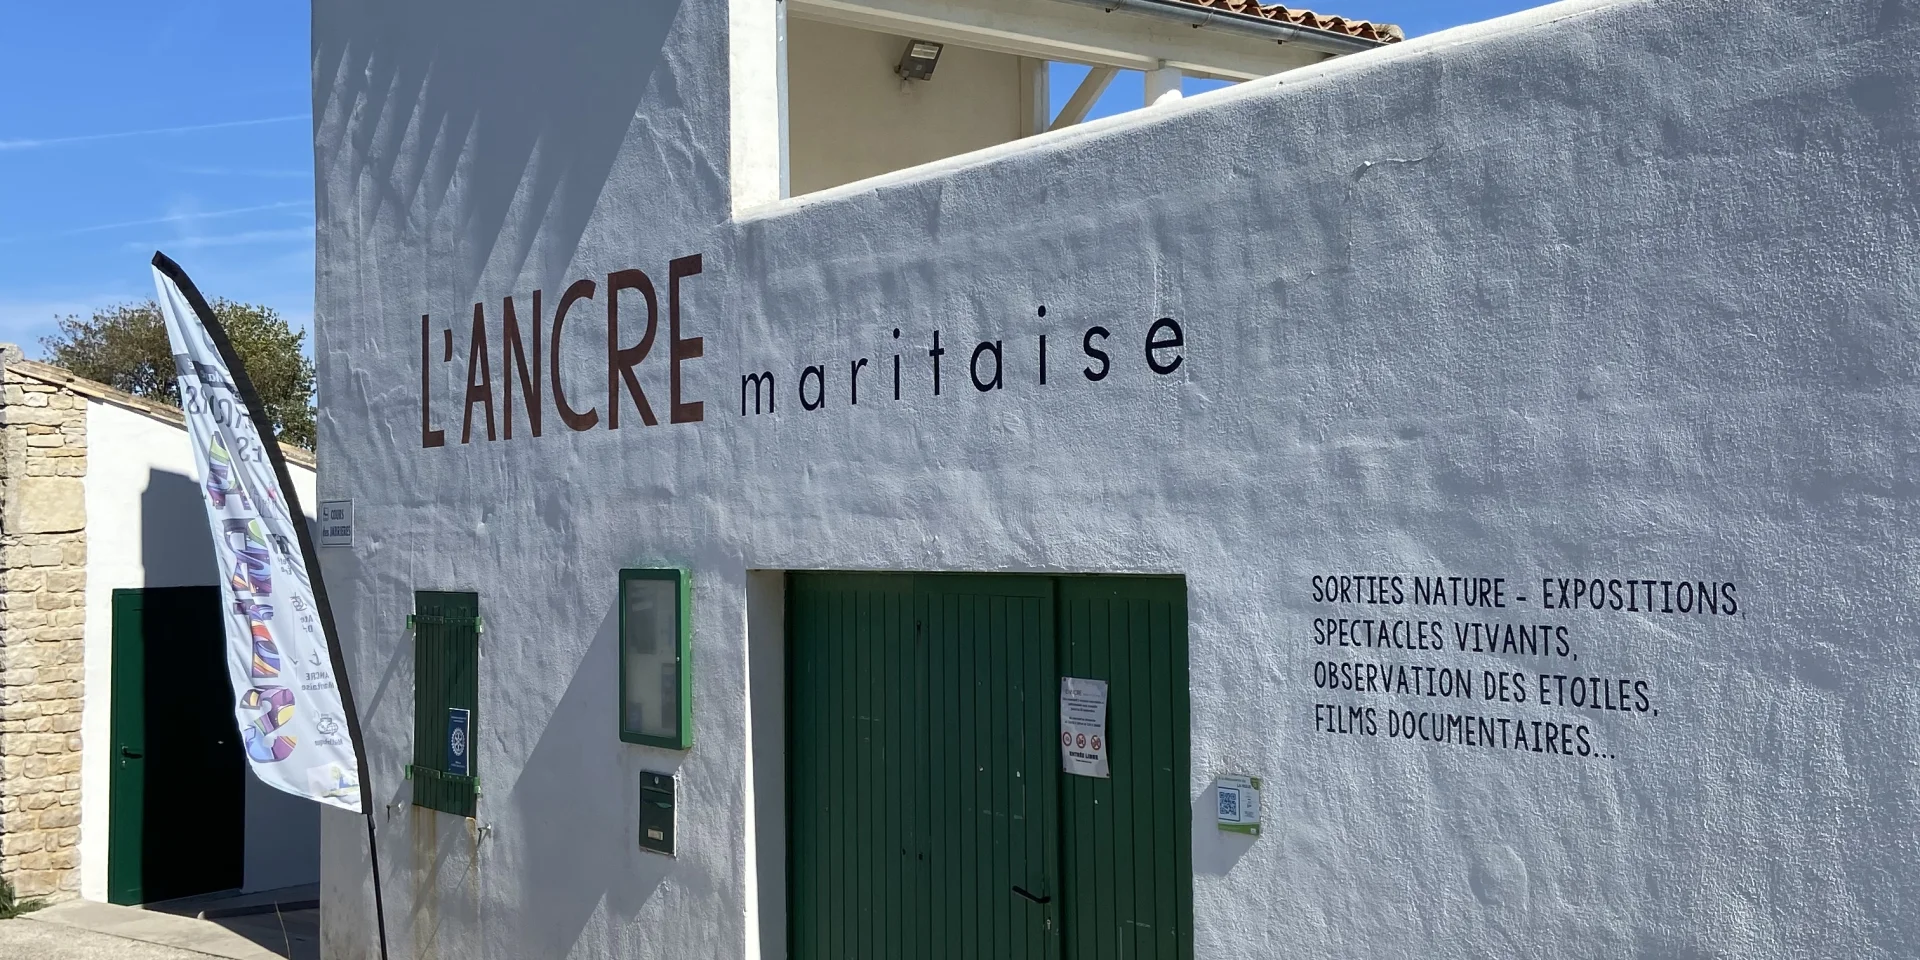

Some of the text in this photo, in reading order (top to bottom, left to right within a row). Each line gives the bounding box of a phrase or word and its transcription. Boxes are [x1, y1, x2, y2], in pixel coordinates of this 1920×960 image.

[422, 254, 1184, 449] L'ANCRE maritaise
[1312, 575, 1404, 605] SORTIES
[1414, 576, 1506, 608] NATURE
[1313, 618, 1578, 661] SPECTACLES VIVANTS,
[1313, 661, 1659, 716] OBSERVATION DES ETOILES,
[1314, 703, 1616, 759] FILMS DOCUMENTAIRES...
